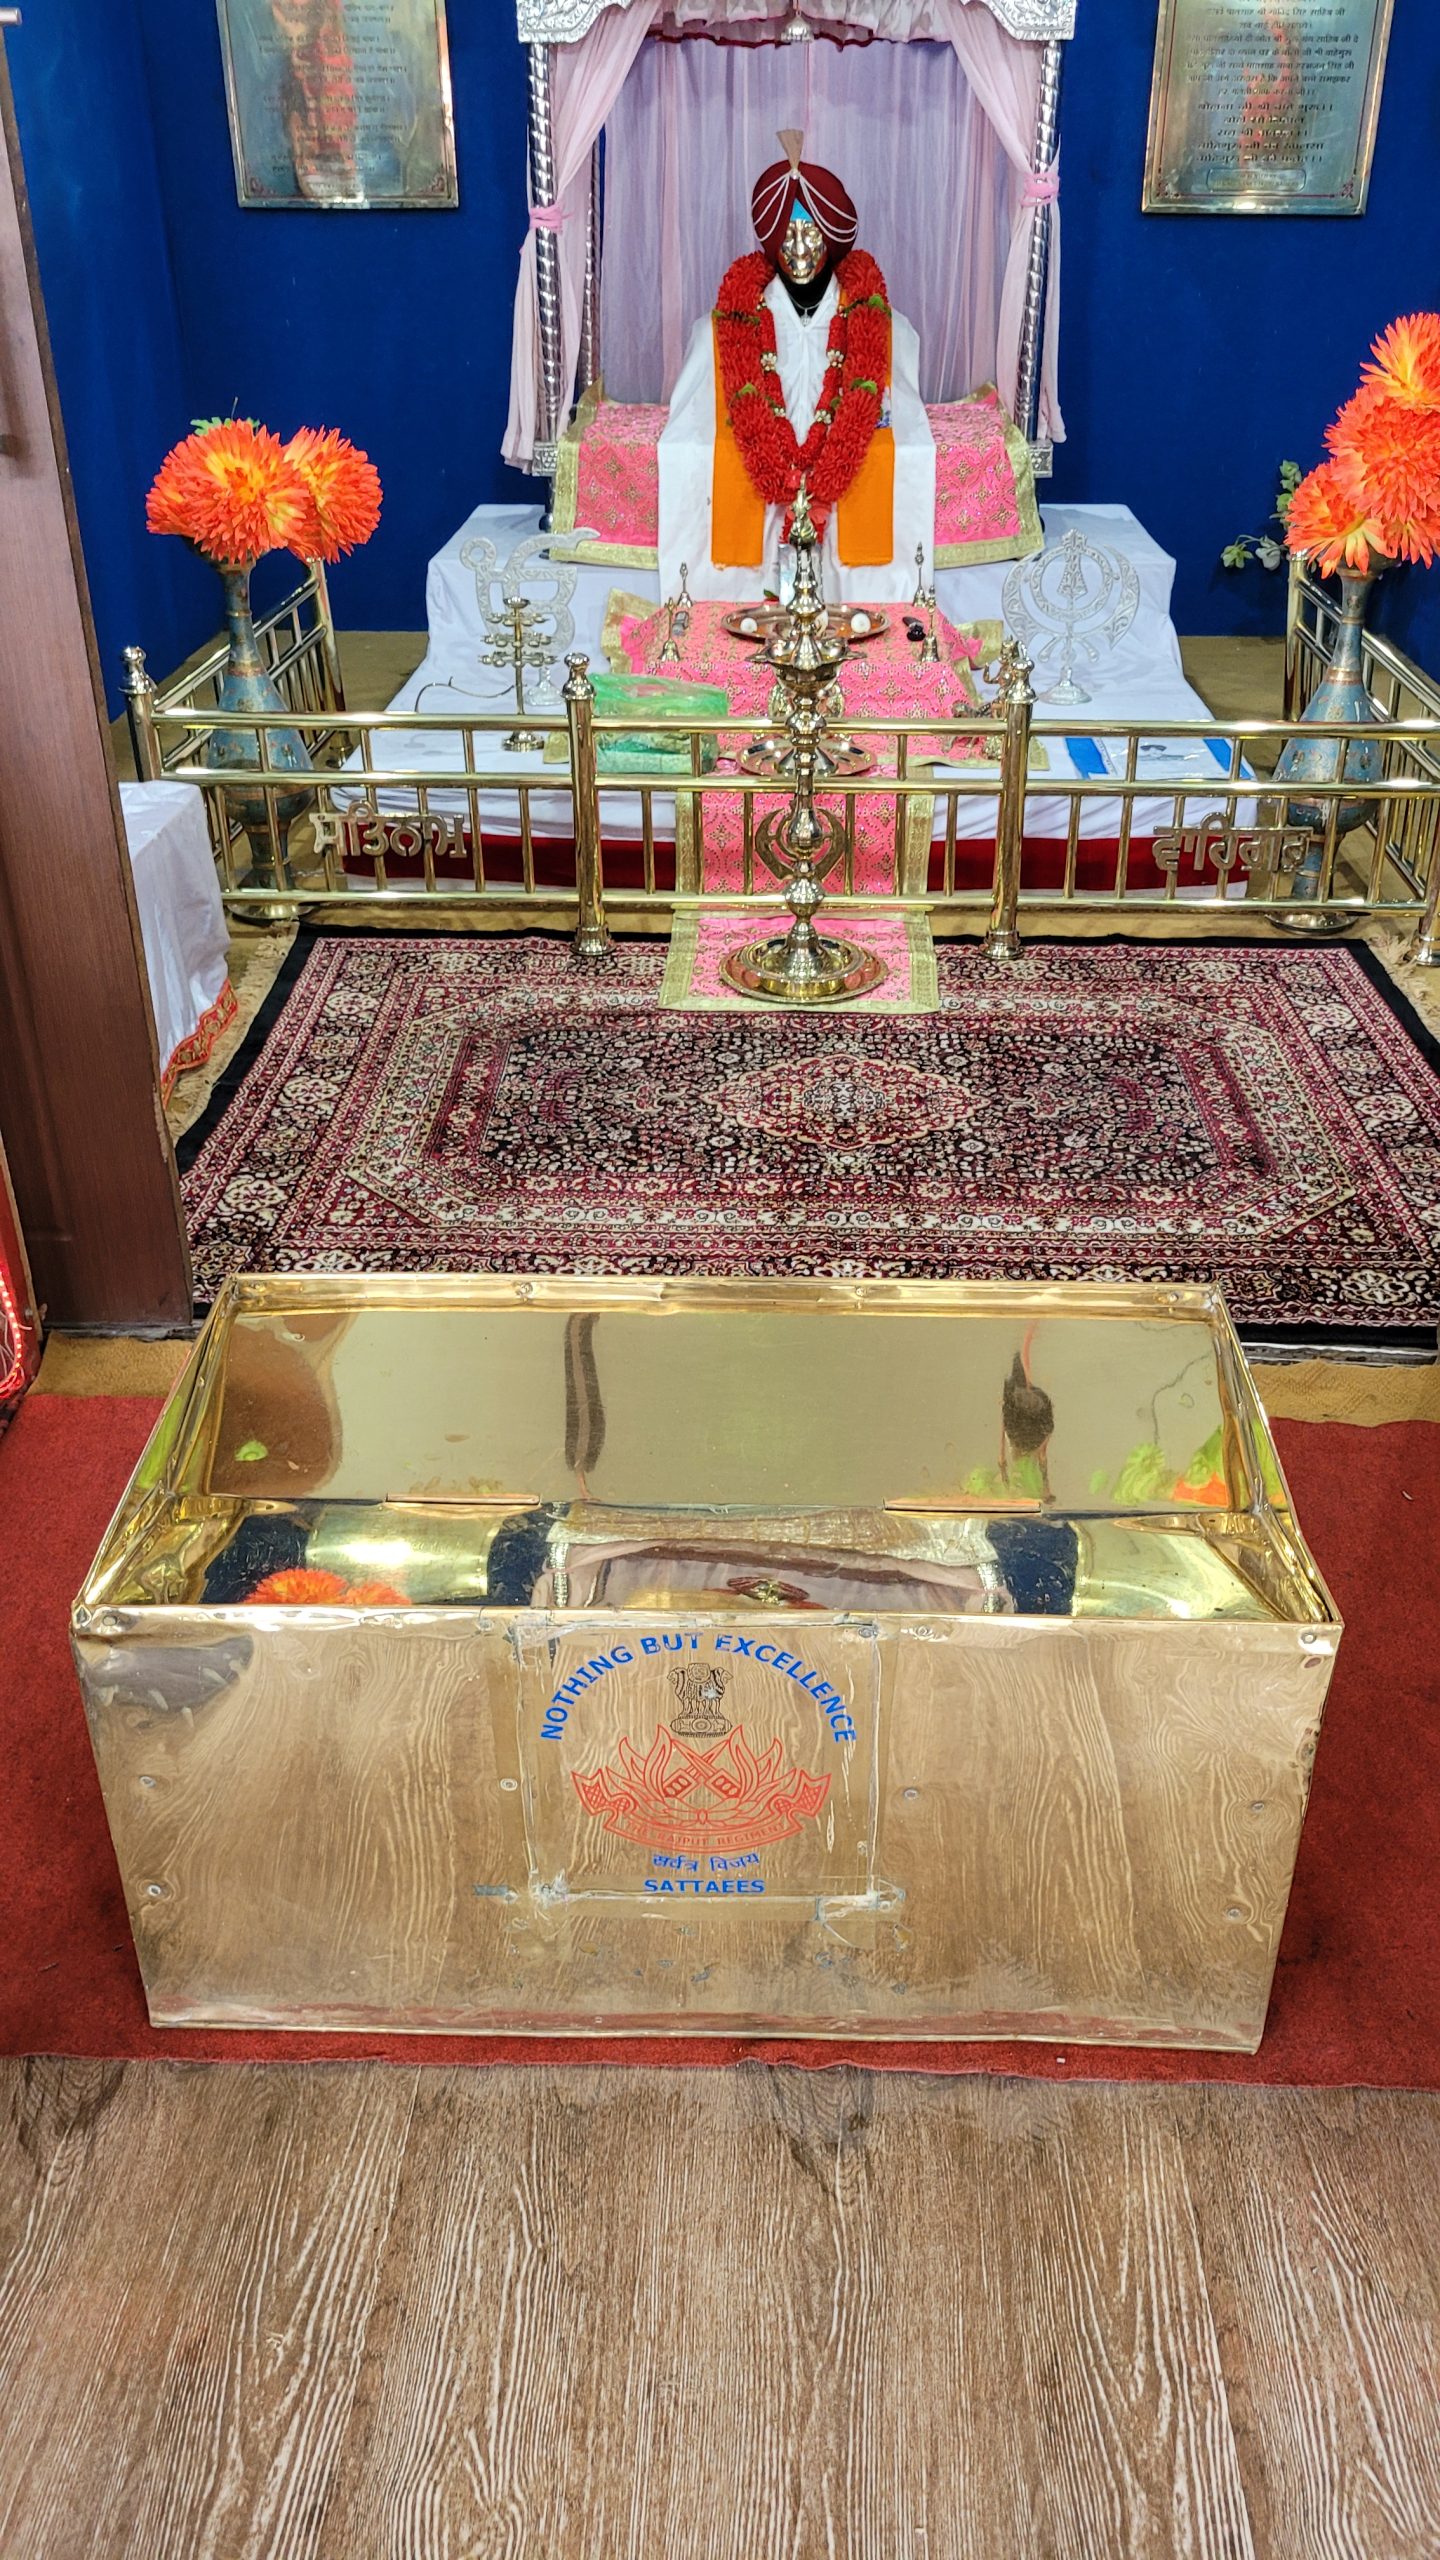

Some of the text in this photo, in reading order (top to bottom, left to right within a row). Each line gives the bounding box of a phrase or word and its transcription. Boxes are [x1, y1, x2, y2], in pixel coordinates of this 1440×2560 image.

[540, 1632, 857, 1743] NOTHING BUT EXCELLENCE
[657, 1831, 709, 1846] RAJPUT
[717, 1821, 785, 1845] REGIMENT
[709, 1852, 760, 1872] विजय
[643, 1878, 766, 1893] SATTAEES
